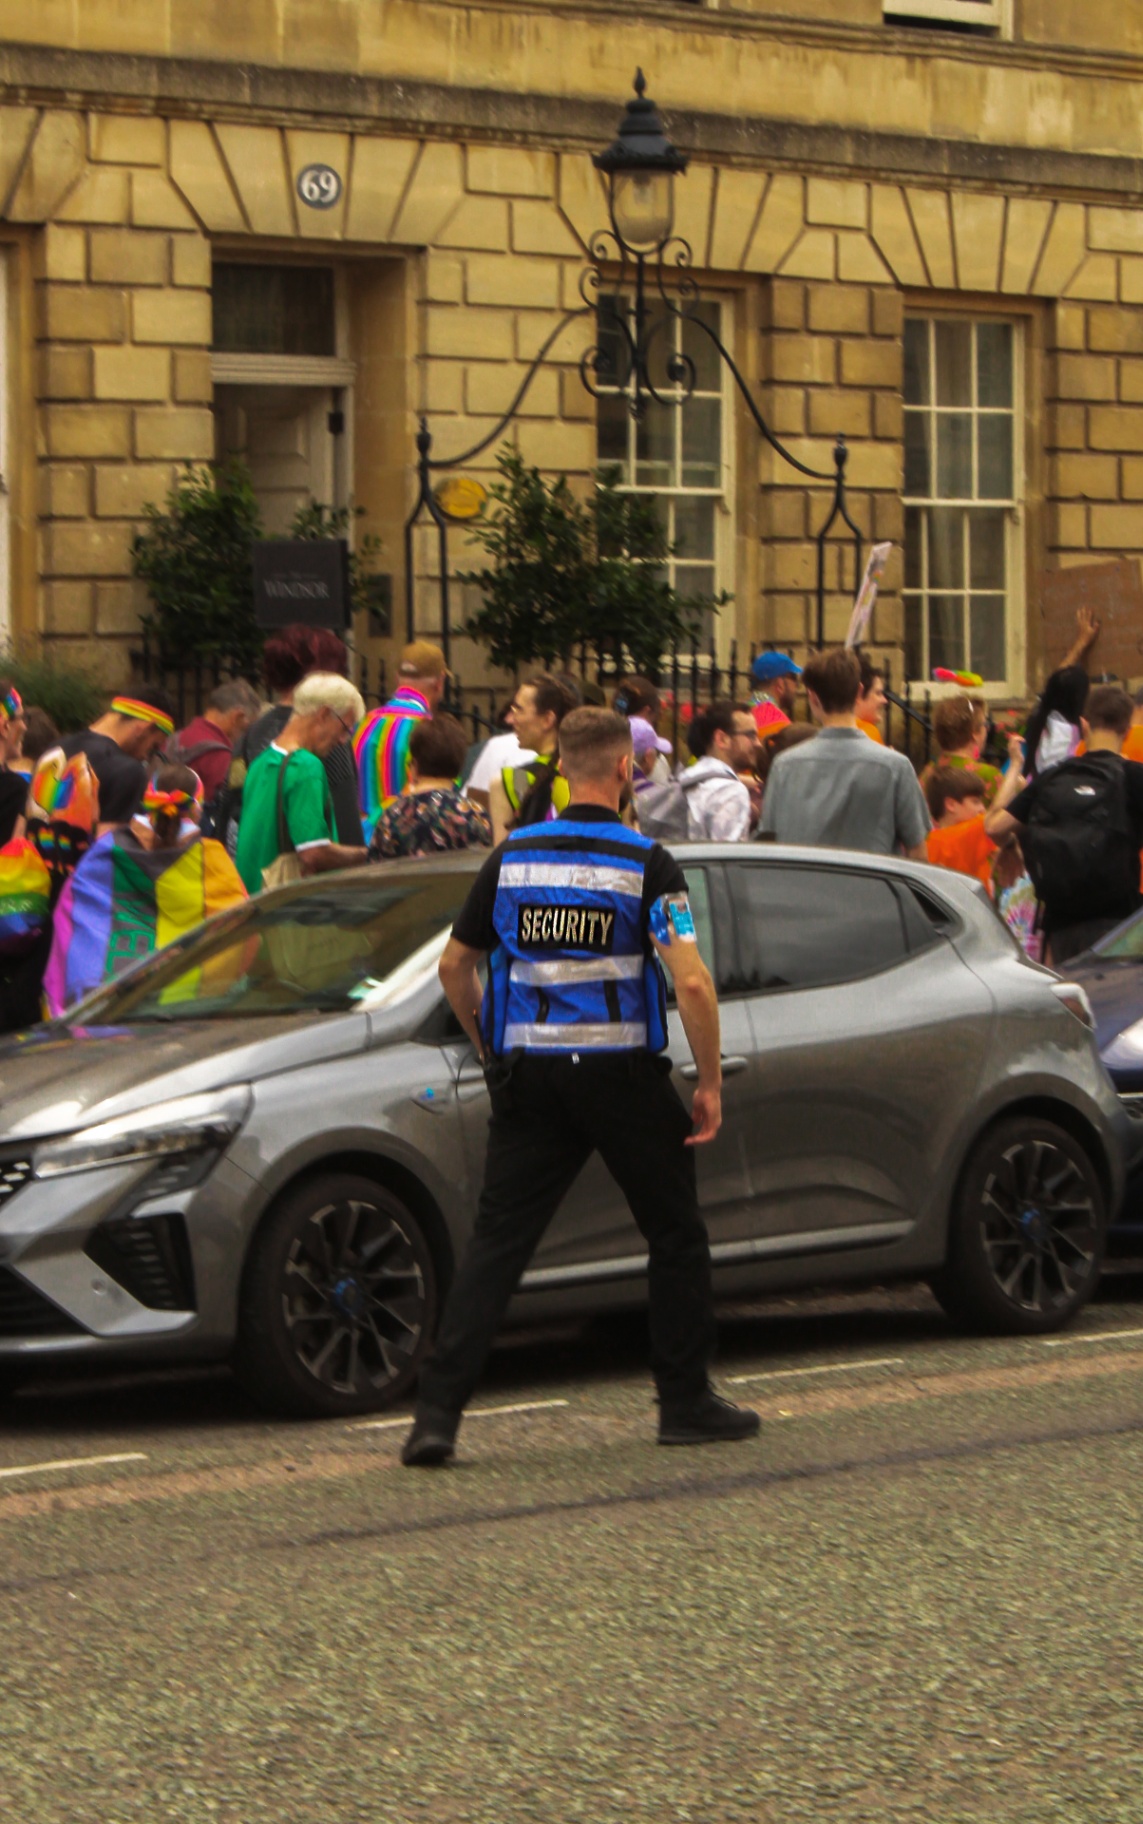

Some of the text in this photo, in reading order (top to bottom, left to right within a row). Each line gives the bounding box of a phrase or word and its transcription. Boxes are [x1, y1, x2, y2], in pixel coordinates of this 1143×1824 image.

[301, 170, 338, 203] 69
[263, 580, 330, 598] WINDSOR
[522, 907, 613, 946] SECURITY
